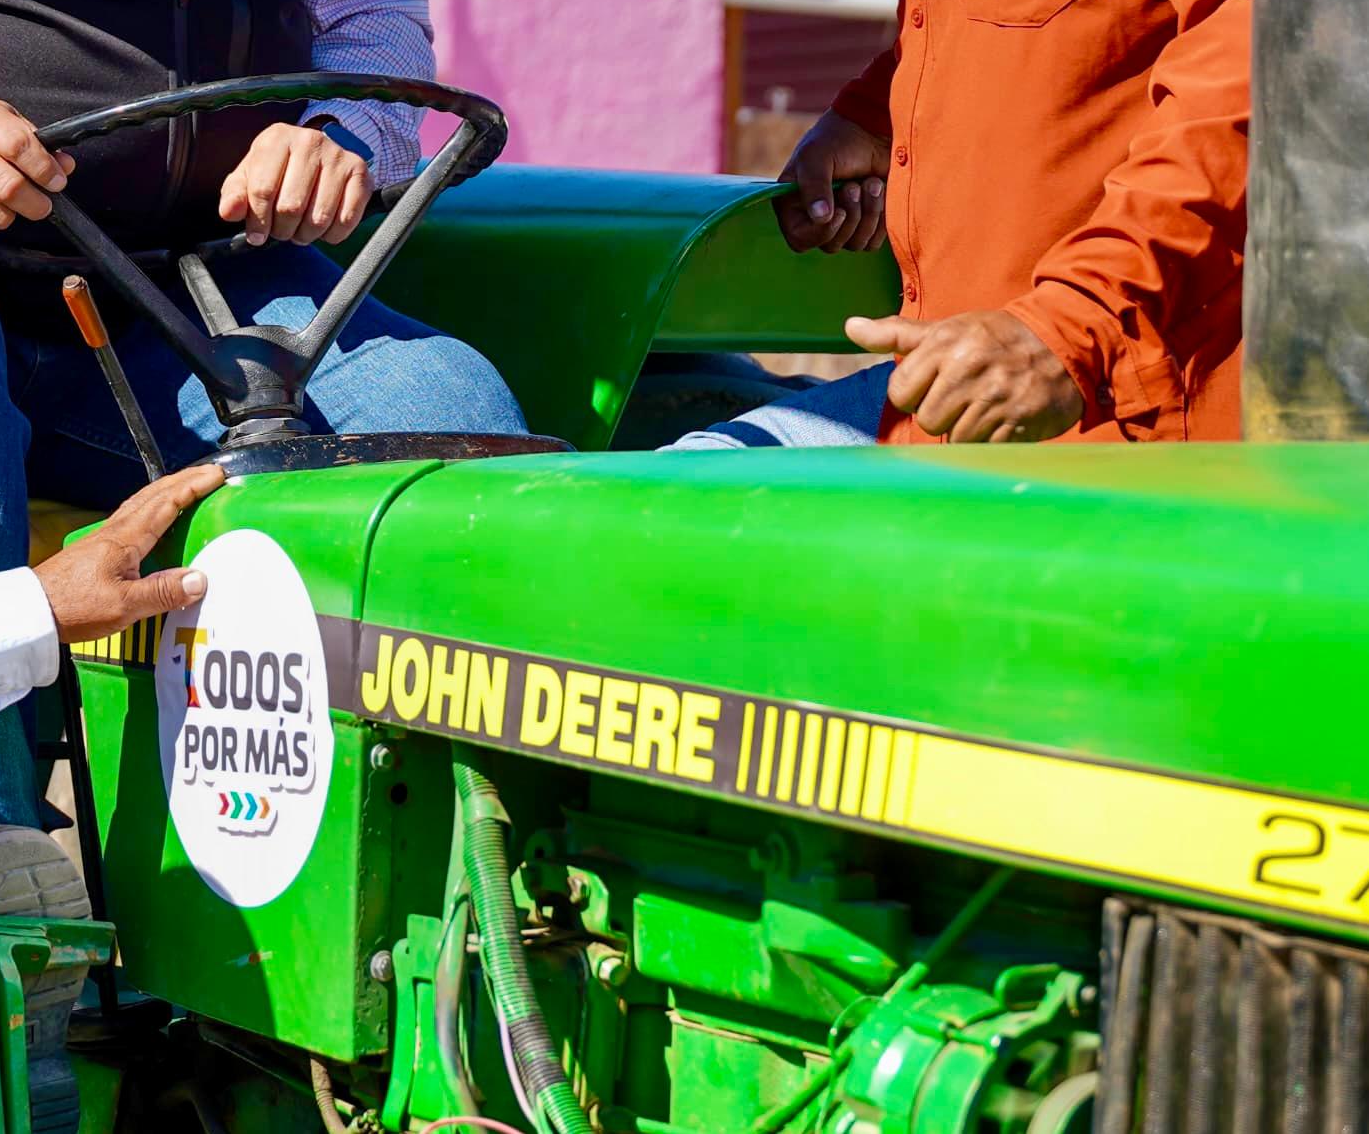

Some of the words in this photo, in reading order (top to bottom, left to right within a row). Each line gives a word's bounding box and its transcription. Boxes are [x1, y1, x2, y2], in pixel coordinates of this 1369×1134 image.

[174, 627, 303, 715] TODOS
[361, 634, 509, 739] JOHN
[520, 663, 722, 783] DEERE
[184, 724, 237, 773] POR
[244, 717, 308, 777] MÁS
